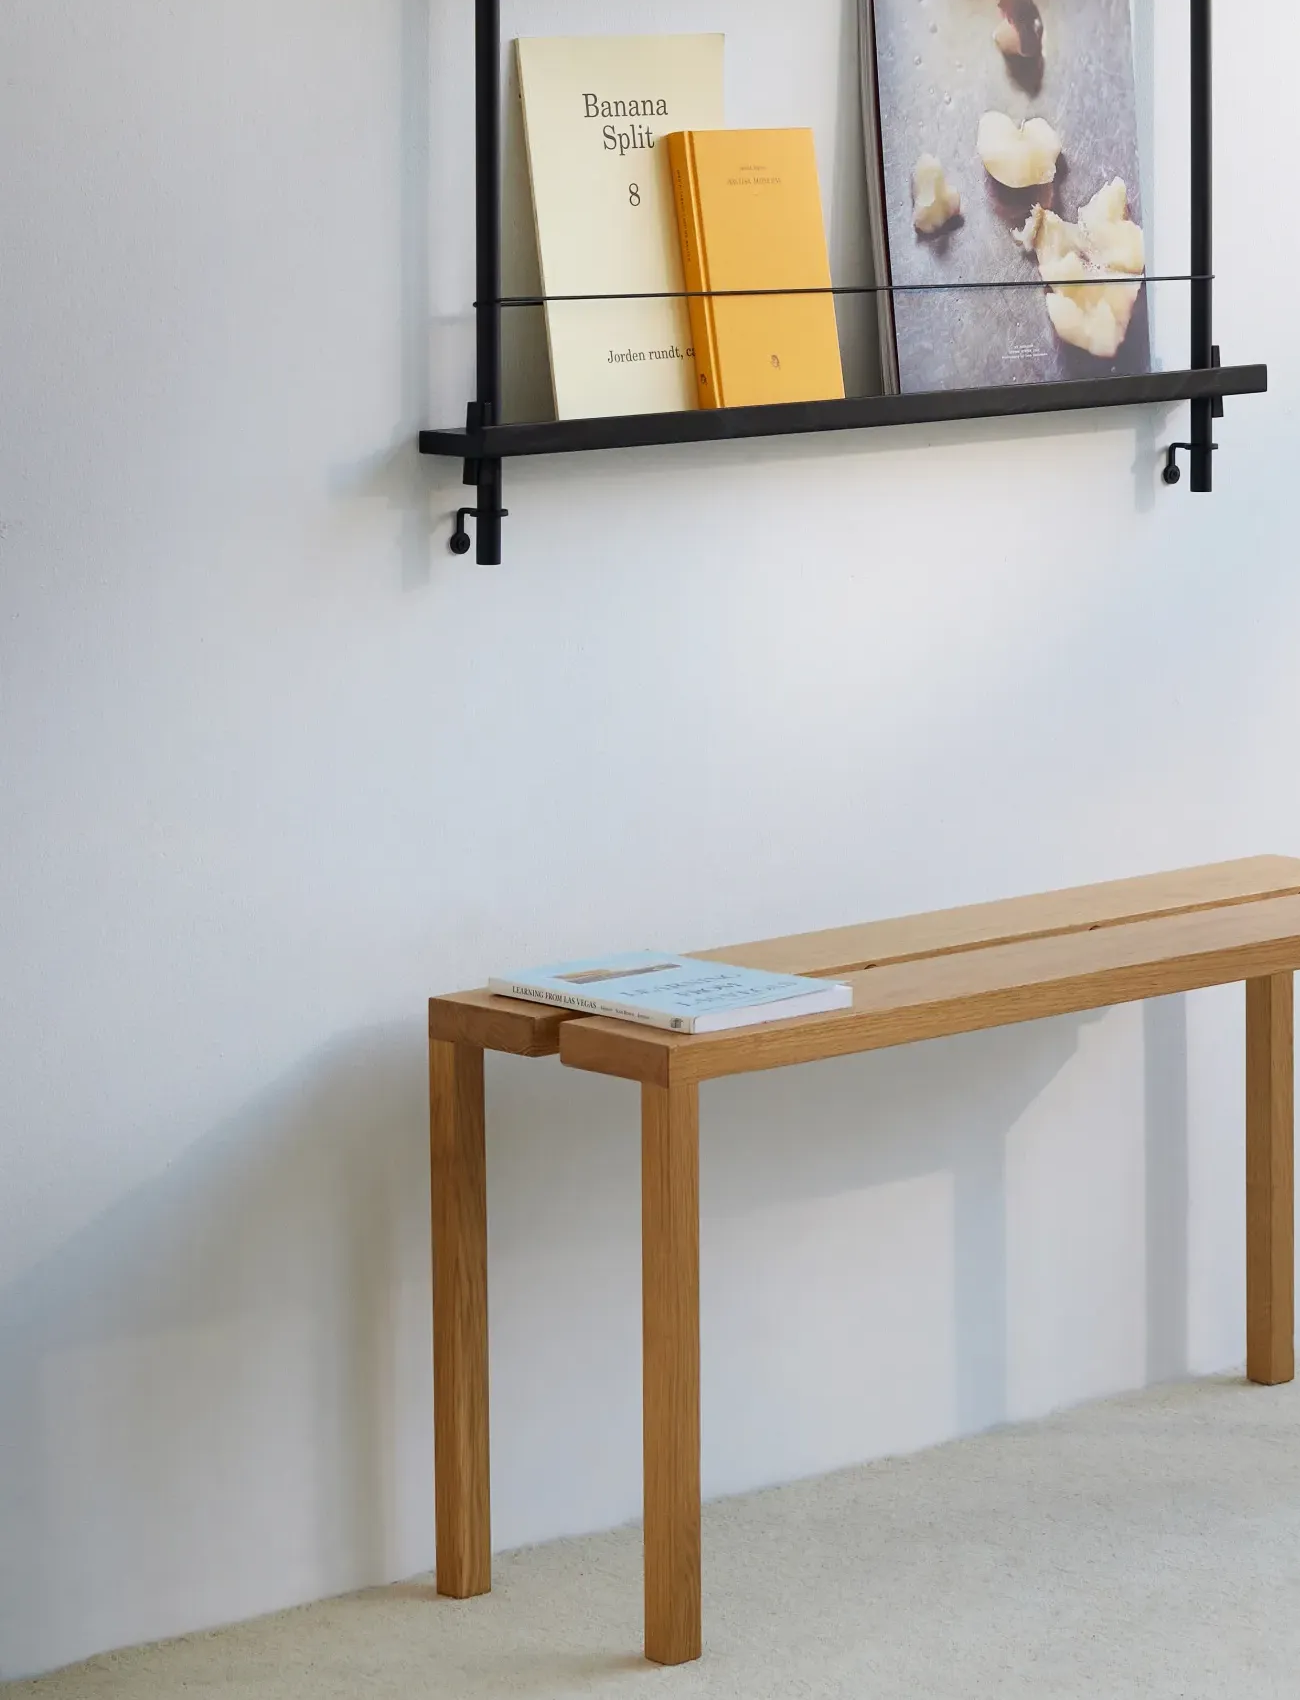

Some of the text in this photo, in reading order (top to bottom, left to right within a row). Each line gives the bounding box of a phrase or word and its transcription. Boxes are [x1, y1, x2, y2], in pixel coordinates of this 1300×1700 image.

[581, 93, 669, 118] Banana
[602, 124, 655, 156] Split
[628, 182, 641, 207] 8
[607, 348, 646, 364] Jorden
[648, 345, 684, 360] rundt,
[512, 985, 544, 999] LEARNING
[544, 992, 563, 1004] FROM
[563, 995, 576, 1005] LAS
[576, 997, 597, 1009] VEGAS
